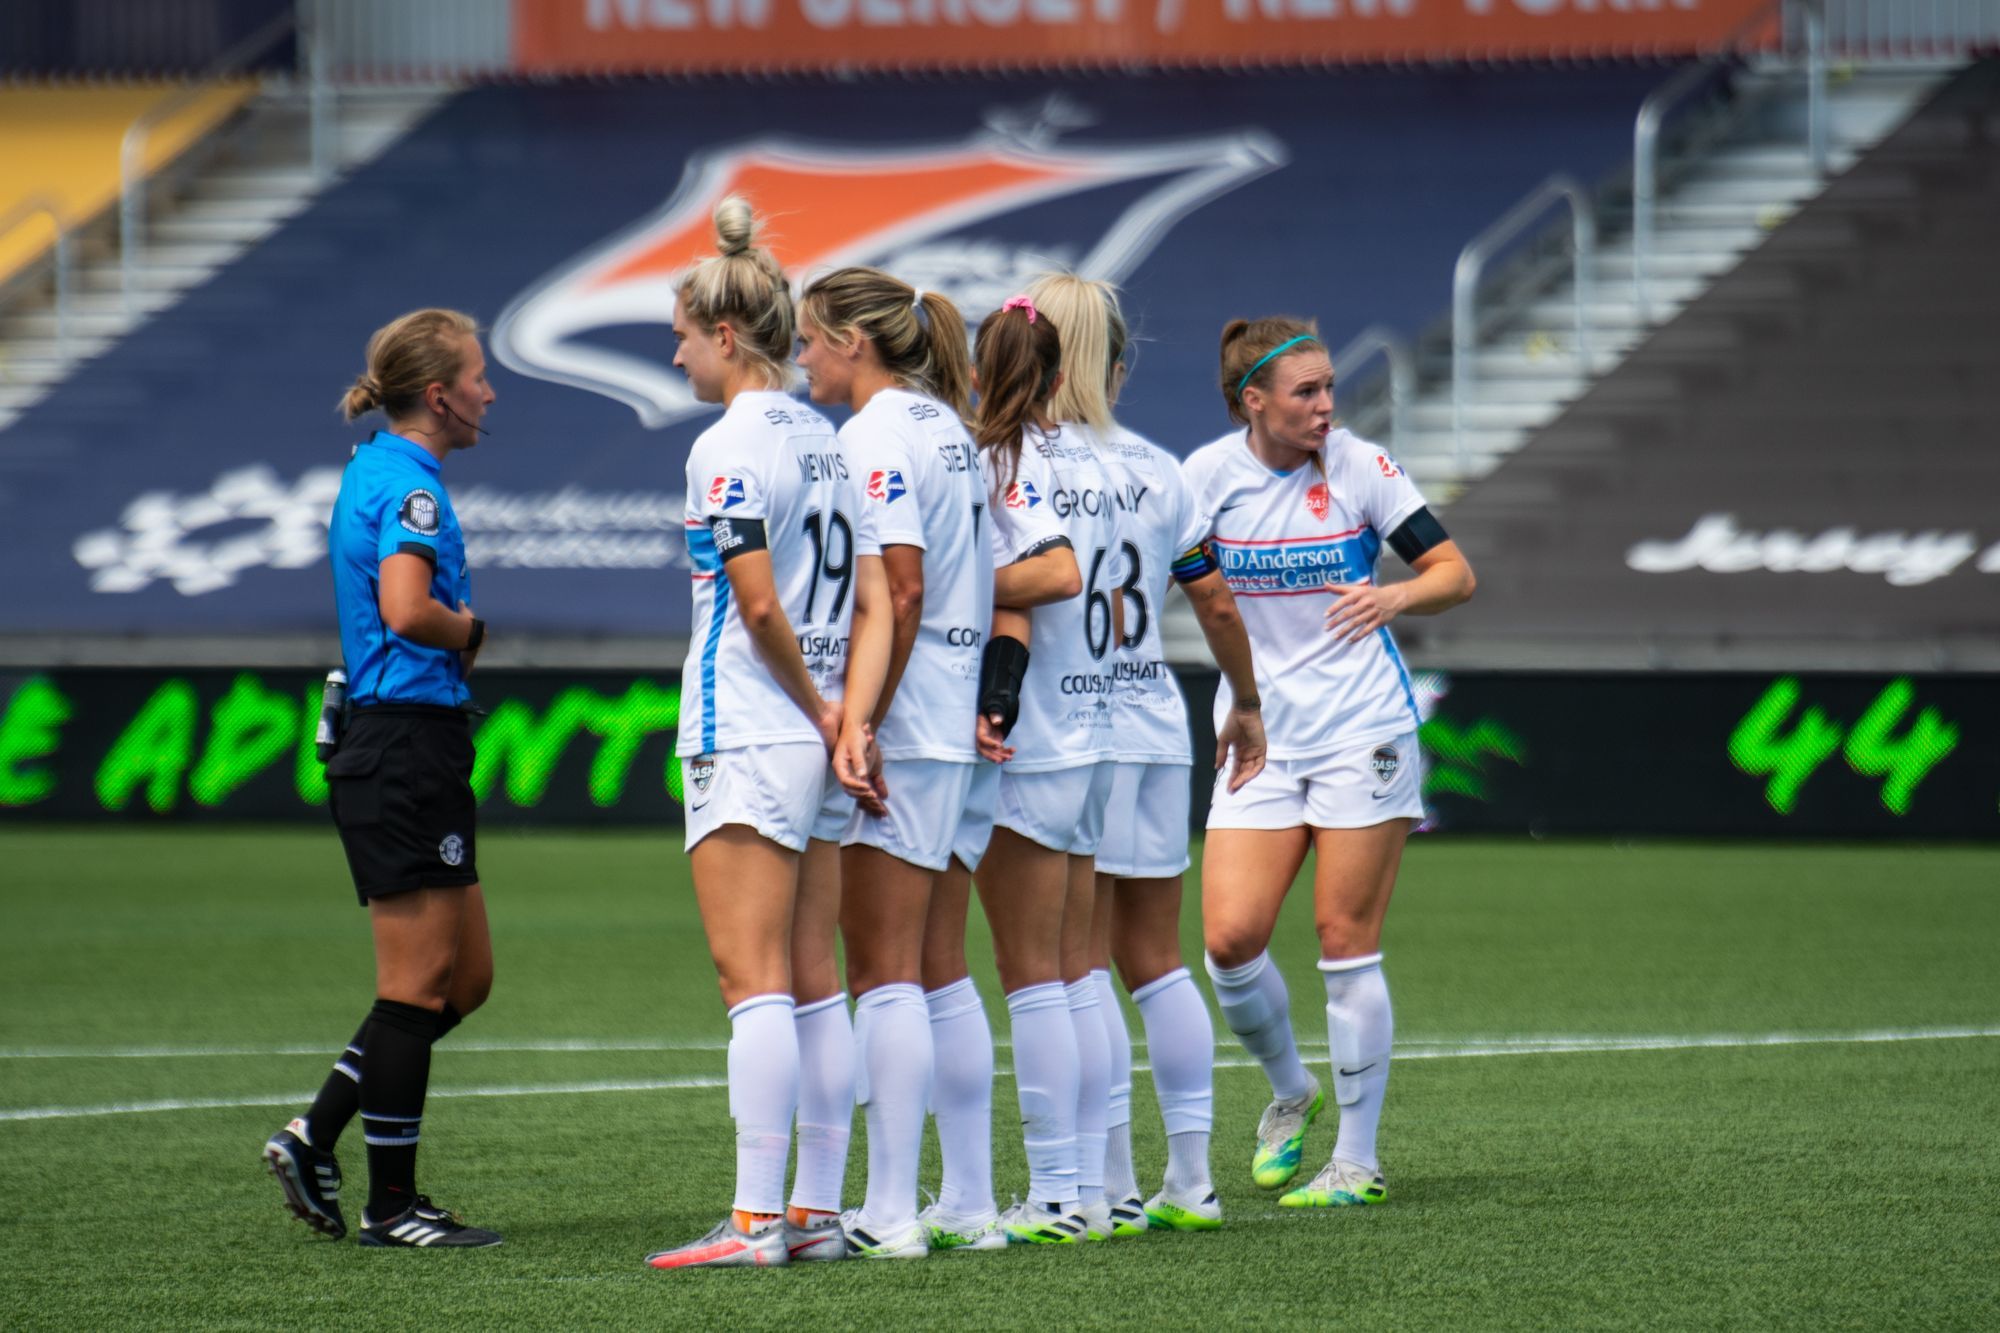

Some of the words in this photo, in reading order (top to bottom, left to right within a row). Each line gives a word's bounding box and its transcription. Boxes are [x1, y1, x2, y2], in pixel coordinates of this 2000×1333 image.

[797, 453, 849, 483] MEWIS
[413, 499, 433, 513] USA
[801, 508, 854, 626] 19
[1218, 549, 1244, 570] MD
[1245, 547, 1345, 570] Anderson
[1281, 567, 1349, 589] Center
[1085, 546, 1111, 662] 6
[1728, 674, 1960, 815] 44
[689, 765, 716, 779] DASH
[1369, 760, 1399, 771] DASH
